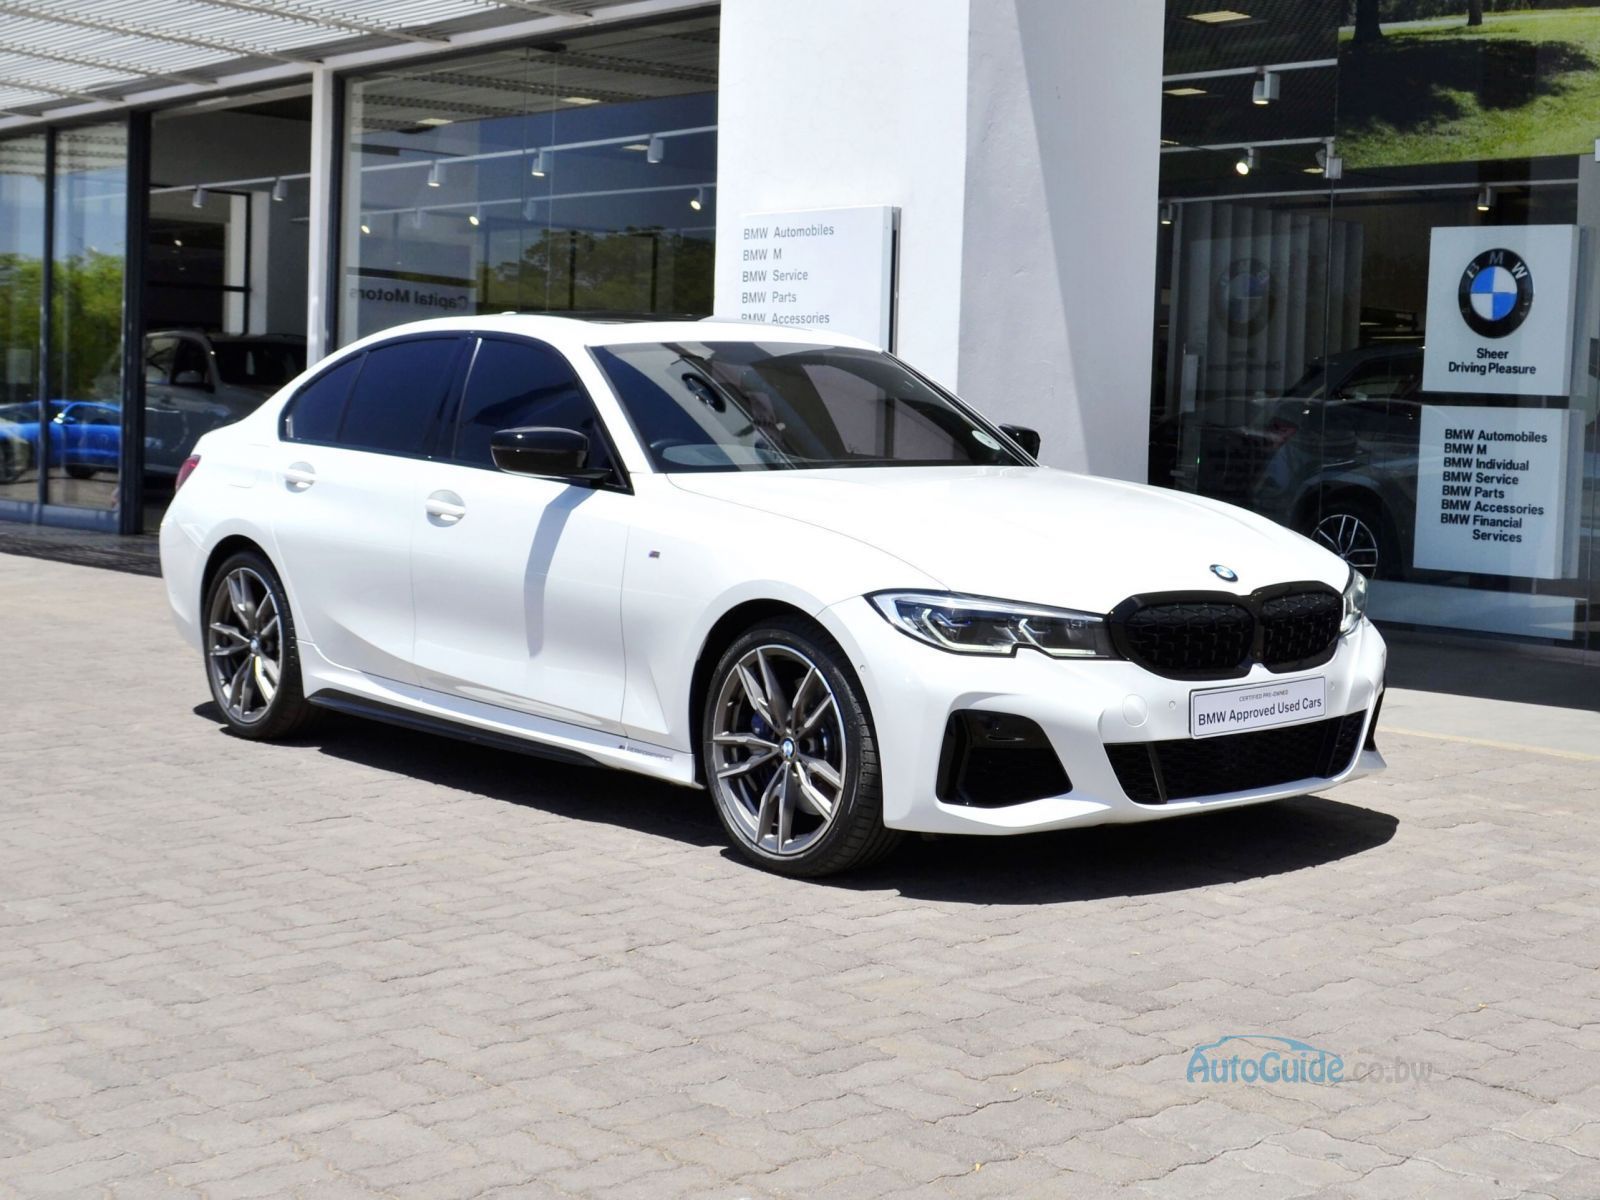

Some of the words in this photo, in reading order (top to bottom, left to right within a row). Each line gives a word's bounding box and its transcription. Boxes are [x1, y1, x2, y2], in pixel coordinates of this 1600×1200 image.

[743, 228, 768, 240] BMW
[773, 224, 834, 238] Automobiles
[743, 249, 767, 261] BMW
[773, 248, 782, 260] M
[742, 271, 767, 282] BMW
[772, 269, 808, 281] Service
[742, 292, 767, 304] BMW
[772, 291, 797, 303] Parts
[772, 312, 830, 324] Accessories
[1477, 348, 1509, 359] Sheer
[1449, 362, 1486, 375] Driving
[1488, 363, 1536, 374] Pleasure
[1445, 429, 1474, 440] BMW
[1478, 430, 1548, 443] Automobiles
[1444, 443, 1473, 454] BMW
[1477, 445, 1487, 454] M
[1444, 457, 1472, 468] BMW
[1476, 458, 1529, 471] Individual
[1443, 471, 1472, 482] BMW
[1476, 473, 1519, 485] Service
[1442, 485, 1471, 496] BMW
[1475, 487, 1505, 499] Parts
[1441, 500, 1471, 511] BMW
[1474, 501, 1544, 515] Accessories
[1441, 513, 1470, 525] BMW
[1473, 515, 1522, 528] Financial
[1472, 529, 1522, 542] Services
[1198, 711, 1226, 726] BMW
[1229, 704, 1275, 723] Approved
[1278, 700, 1300, 713] Used
[1302, 697, 1322, 709] Cars
